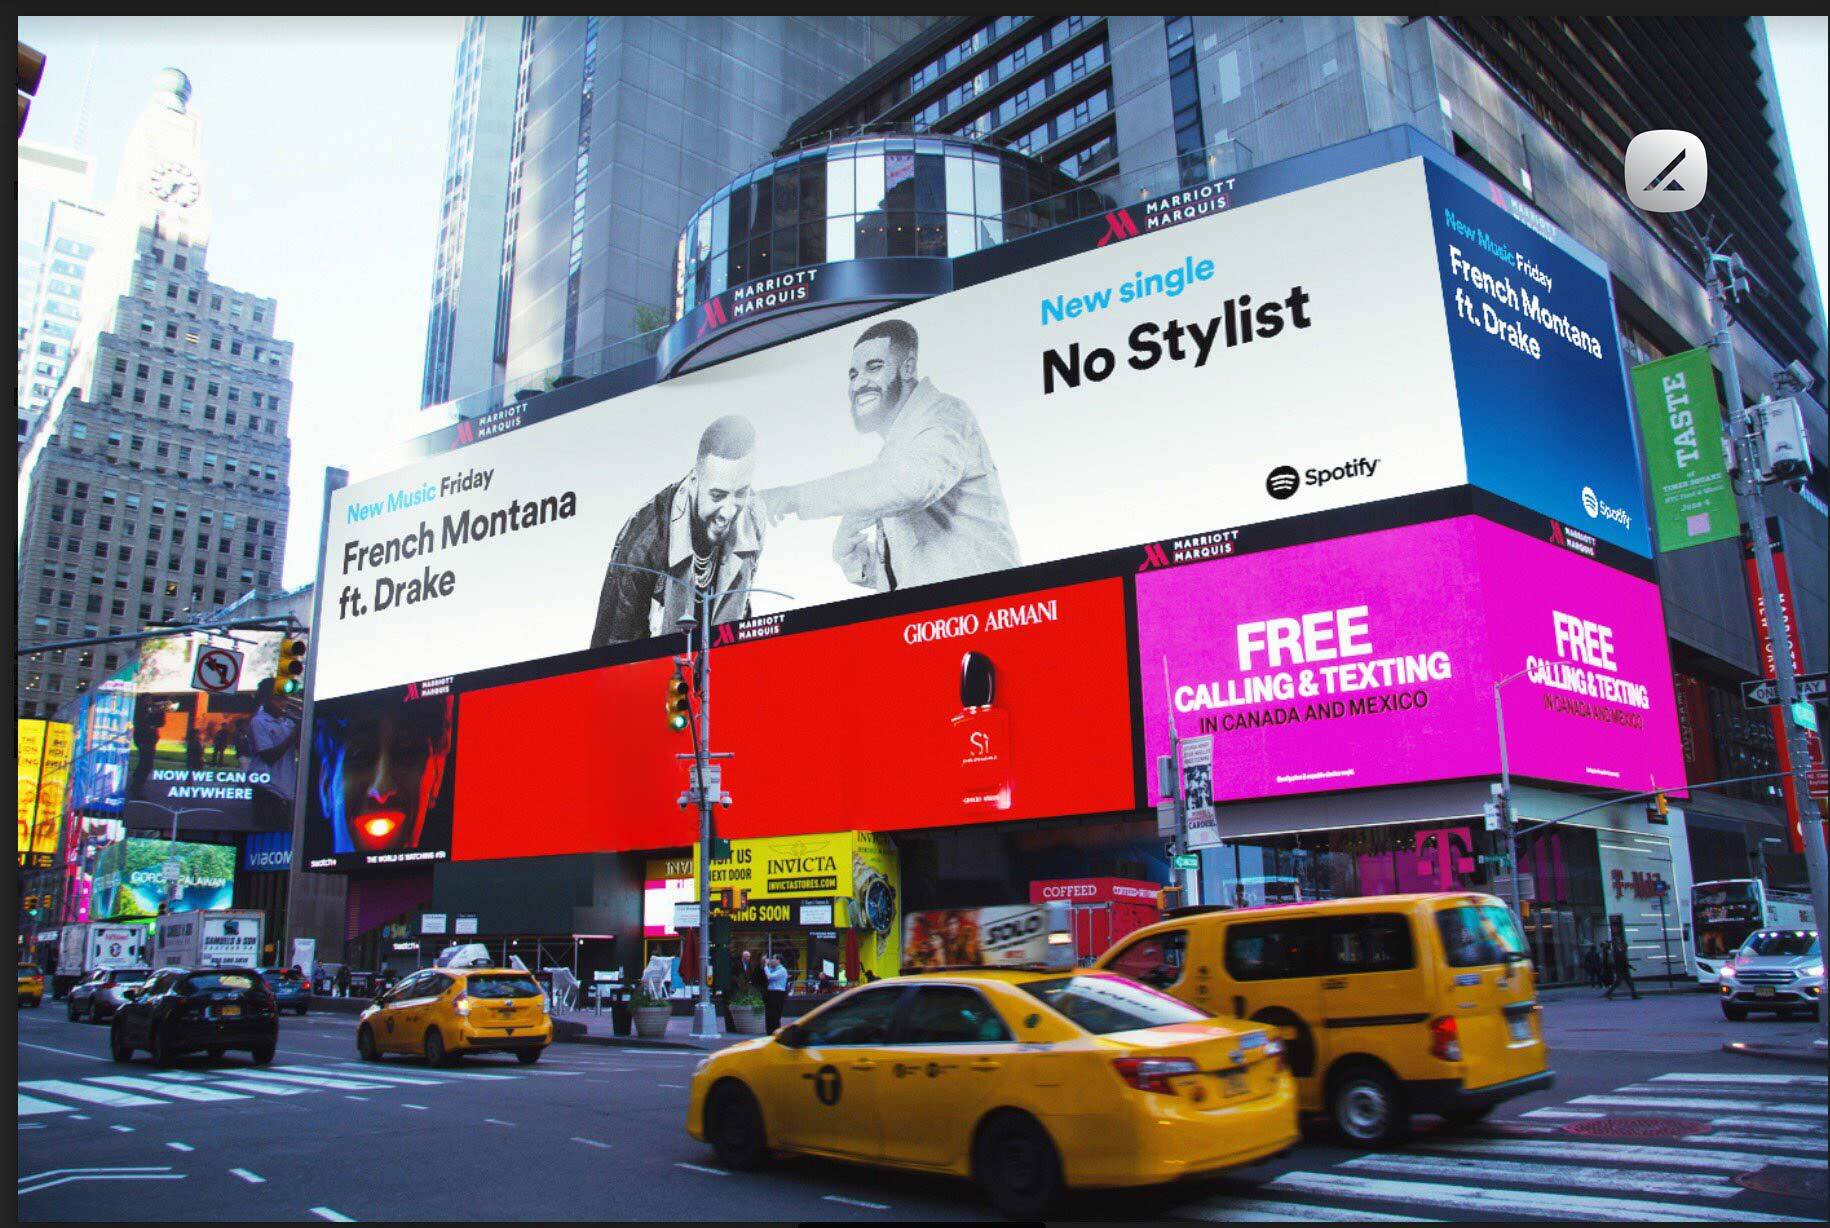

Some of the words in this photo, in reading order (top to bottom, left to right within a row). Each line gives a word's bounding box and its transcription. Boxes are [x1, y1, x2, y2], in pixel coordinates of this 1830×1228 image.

[1146, 178, 1236, 214] MARRIOTT
[1147, 196, 1228, 229] MARQUIS
[1445, 208, 1475, 242] New
[1478, 229, 1515, 266] Music
[1516, 252, 1552, 293] Friday
[734, 269, 817, 301] MARRIOTT
[1041, 288, 1112, 326] New
[1119, 256, 1215, 298] single
[733, 287, 807, 317] MARQUIS
[1450, 244, 1519, 314] French
[1521, 287, 1603, 360] Montana
[1043, 342, 1116, 395] No
[1127, 285, 1312, 370] Stylist
[1455, 288, 1481, 328] ft.
[1481, 303, 1541, 361] Drake
[479, 404, 528, 426] MARRIOTT
[479, 416, 521, 437] MARQUIS
[1661, 372, 1699, 469] TASTE
[1305, 457, 1377, 487] Spotify
[347, 502, 384, 524] New
[387, 482, 437, 514] Music
[440, 467, 495, 498] Friday
[1599, 500, 1631, 531] Spotify
[342, 520, 434, 575] French
[441, 491, 577, 550] Montana
[1174, 530, 1239, 549] MARRIOTT
[1174, 543, 1232, 561] MARQUIS
[339, 585, 368, 620] ft.
[374, 565, 456, 613] Drake
[738, 614, 786, 630] MARRIOTT
[738, 625, 780, 640] MARQUIS
[903, 613, 979, 645] GIORGIO
[984, 599, 1058, 633] ARMANI
[1236, 605, 1373, 672] FREE
[1552, 609, 1617, 672] FREE
[1174, 672, 1295, 713] CALLING
[1298, 668, 1320, 698] &
[1319, 651, 1453, 695] TEXTING
[1526, 655, 1588, 695] CALLING
[1595, 673, 1650, 710] TEXTING
[1200, 716, 1219, 734] IN
[1222, 706, 1300, 732] CANADA
[1304, 701, 1346, 723] AND
[1350, 690, 1428, 717] MEXICO
[153, 769, 190, 781] NOW
[192, 770, 215, 782] WE
[216, 771, 247, 783] CAN
[249, 772, 271, 784] GO
[168, 786, 253, 800] ANYWHERE
[736, 848, 752, 864] US
[767, 856, 837, 875] INVICTA
[729, 868, 751, 880] DOOR
[768, 878, 836, 892] INVICTASTORES.COM
[1043, 885, 1097, 898] COFFEED
[759, 905, 790, 921] SOON
